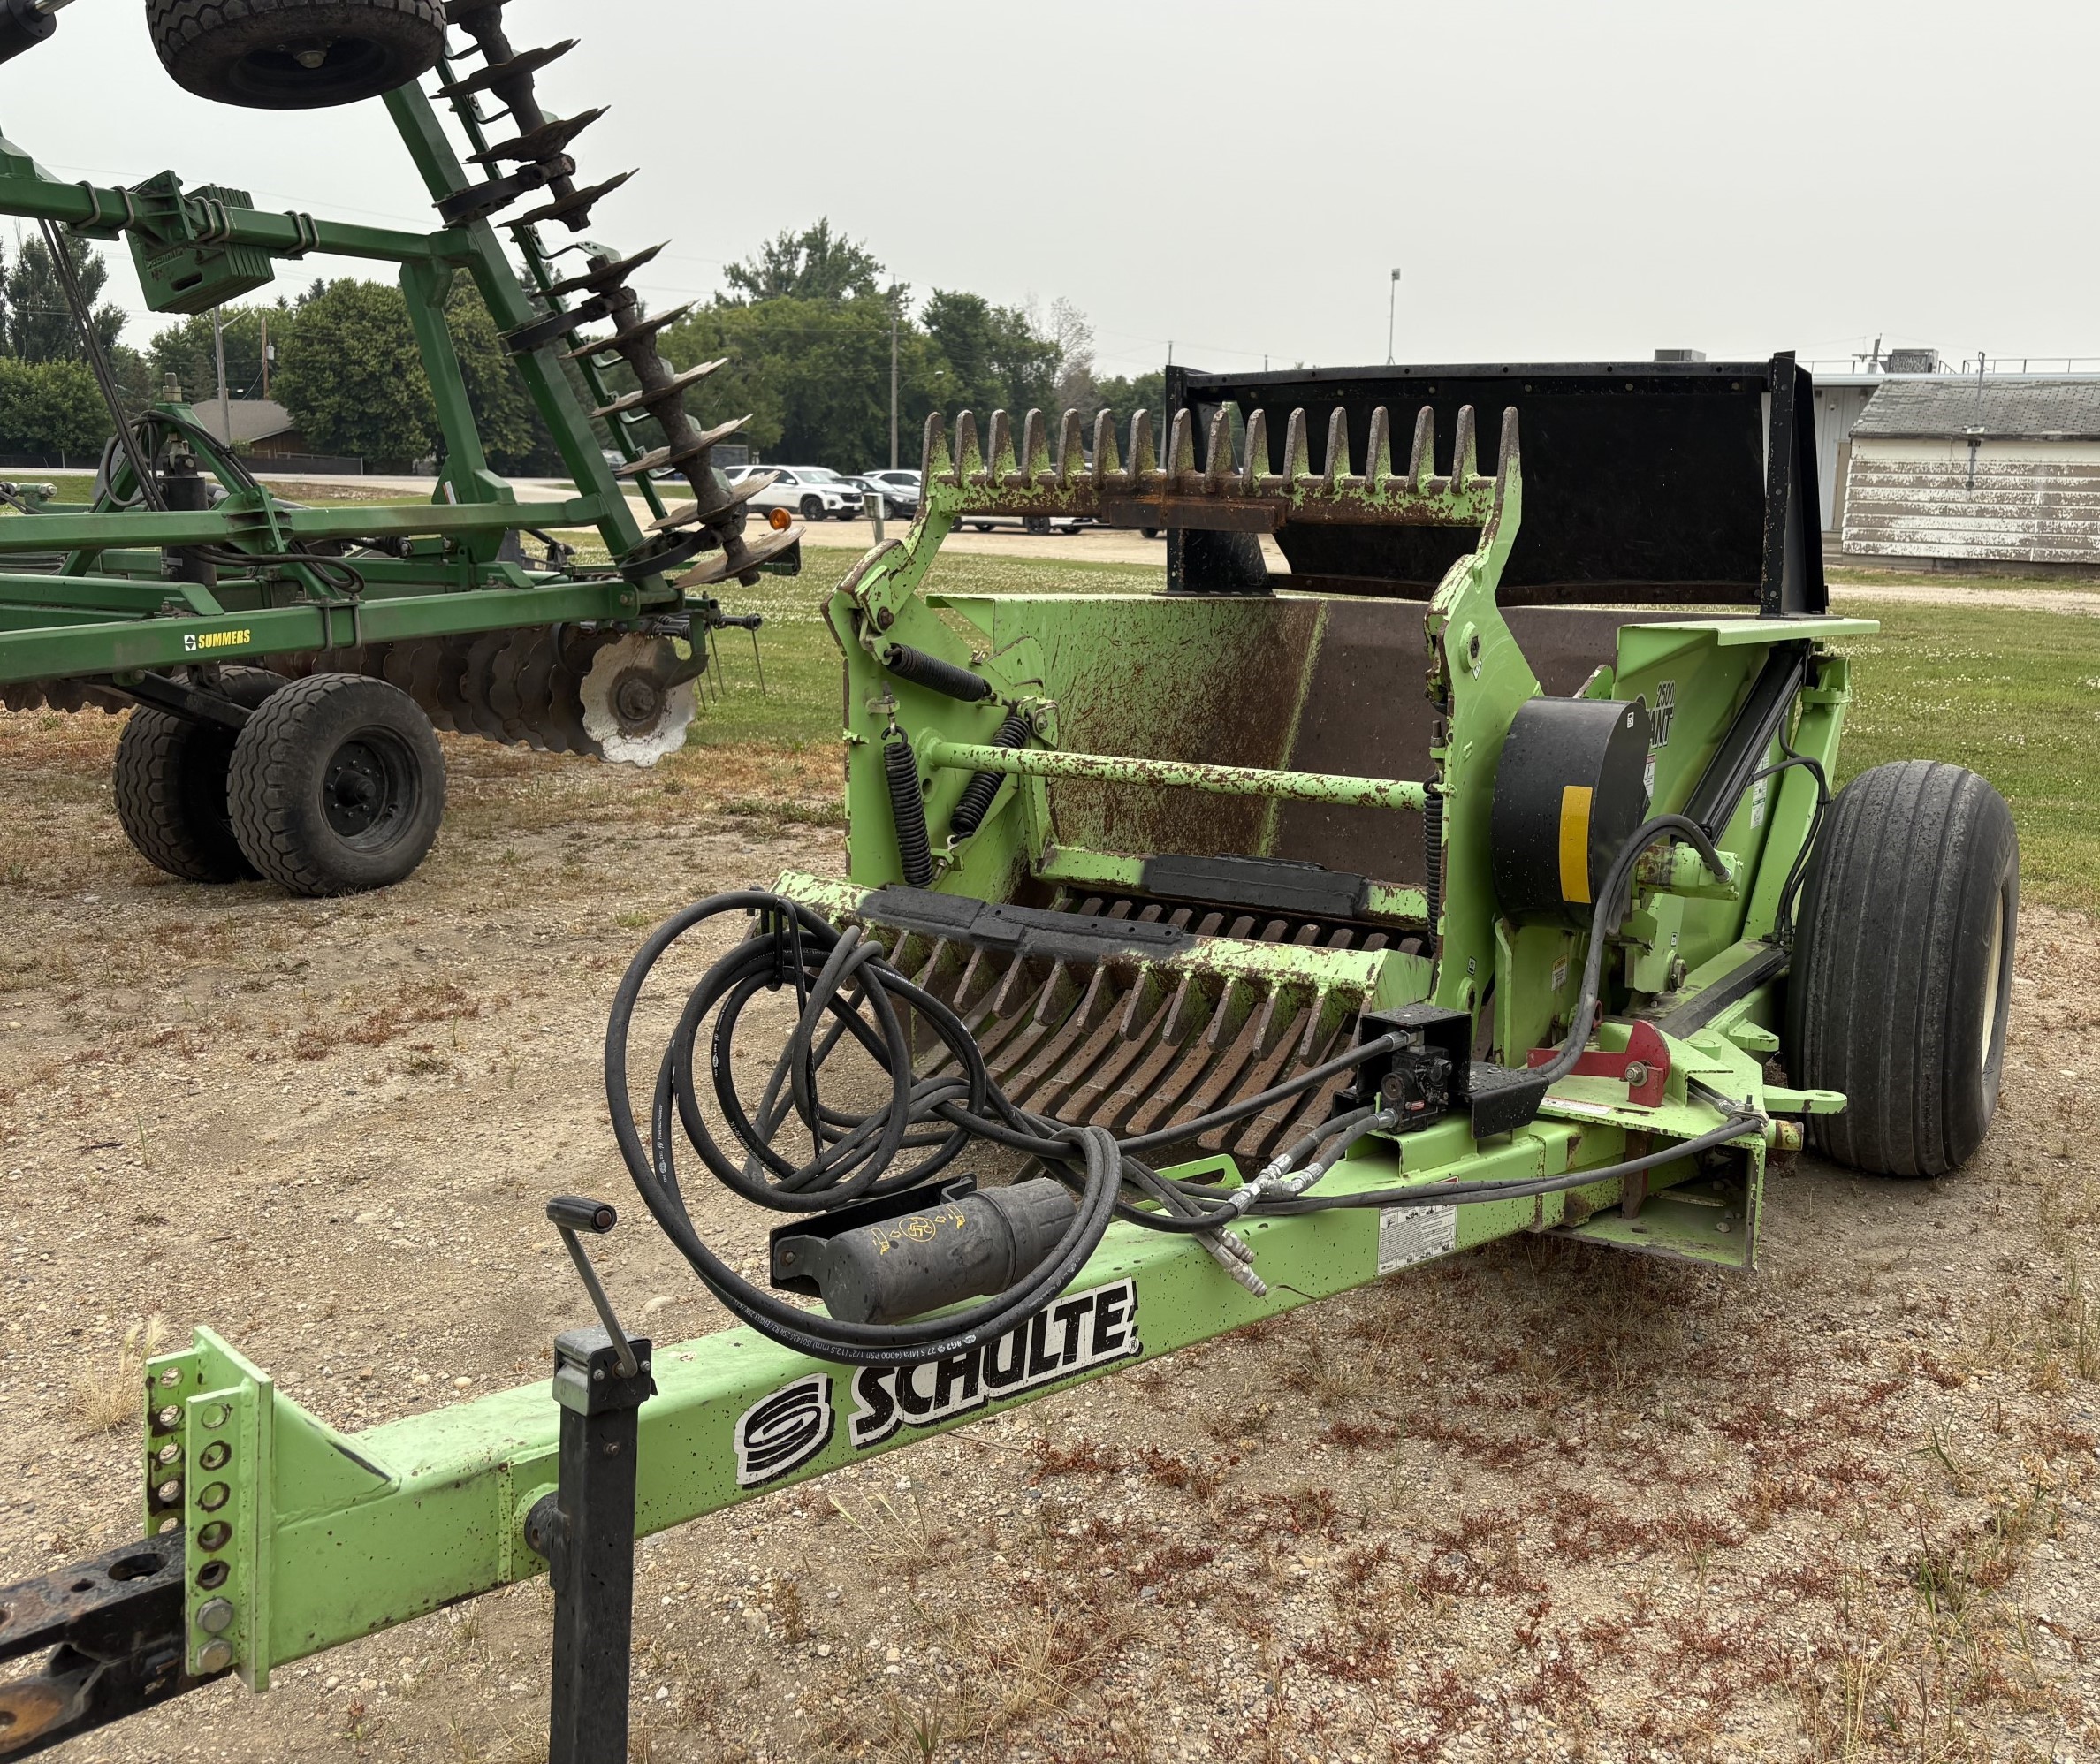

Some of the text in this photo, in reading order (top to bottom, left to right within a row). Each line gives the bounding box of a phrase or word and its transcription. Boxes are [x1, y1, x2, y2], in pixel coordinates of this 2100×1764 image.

[198, 629, 250, 649] SUMMERS
[1656, 681, 1675, 708] 2500
[855, 1284, 1130, 1438] SCHULTE
